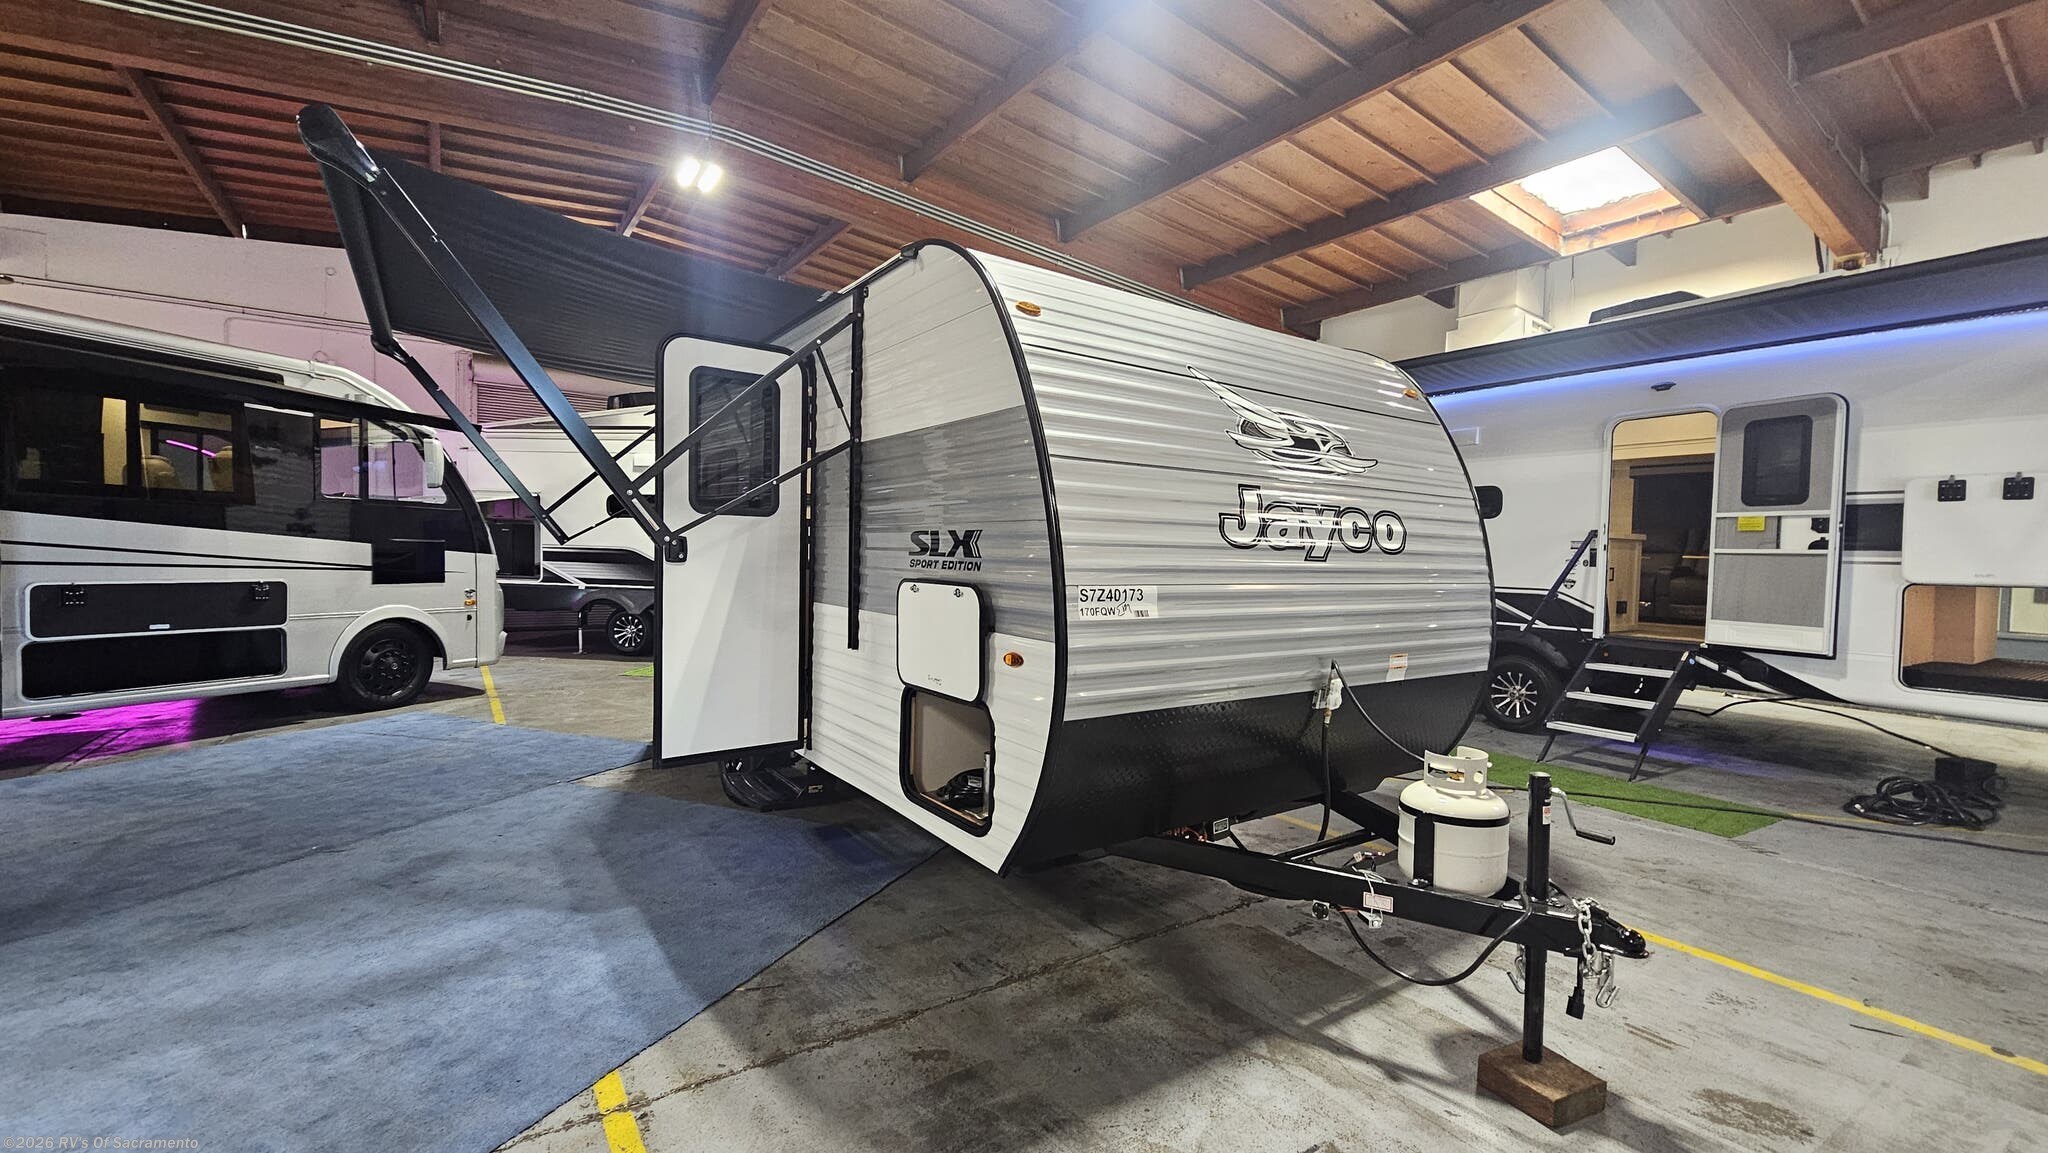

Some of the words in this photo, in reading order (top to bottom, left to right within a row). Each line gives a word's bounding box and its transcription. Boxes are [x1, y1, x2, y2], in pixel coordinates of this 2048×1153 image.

[1219, 484, 1407, 562] Jayco
[908, 529, 983, 559] SLX
[909, 559, 939, 569] SPORT
[941, 561, 982, 572] EDITION
[1079, 588, 1144, 602] S7Z40173
[1079, 607, 1116, 617] 170FQW
